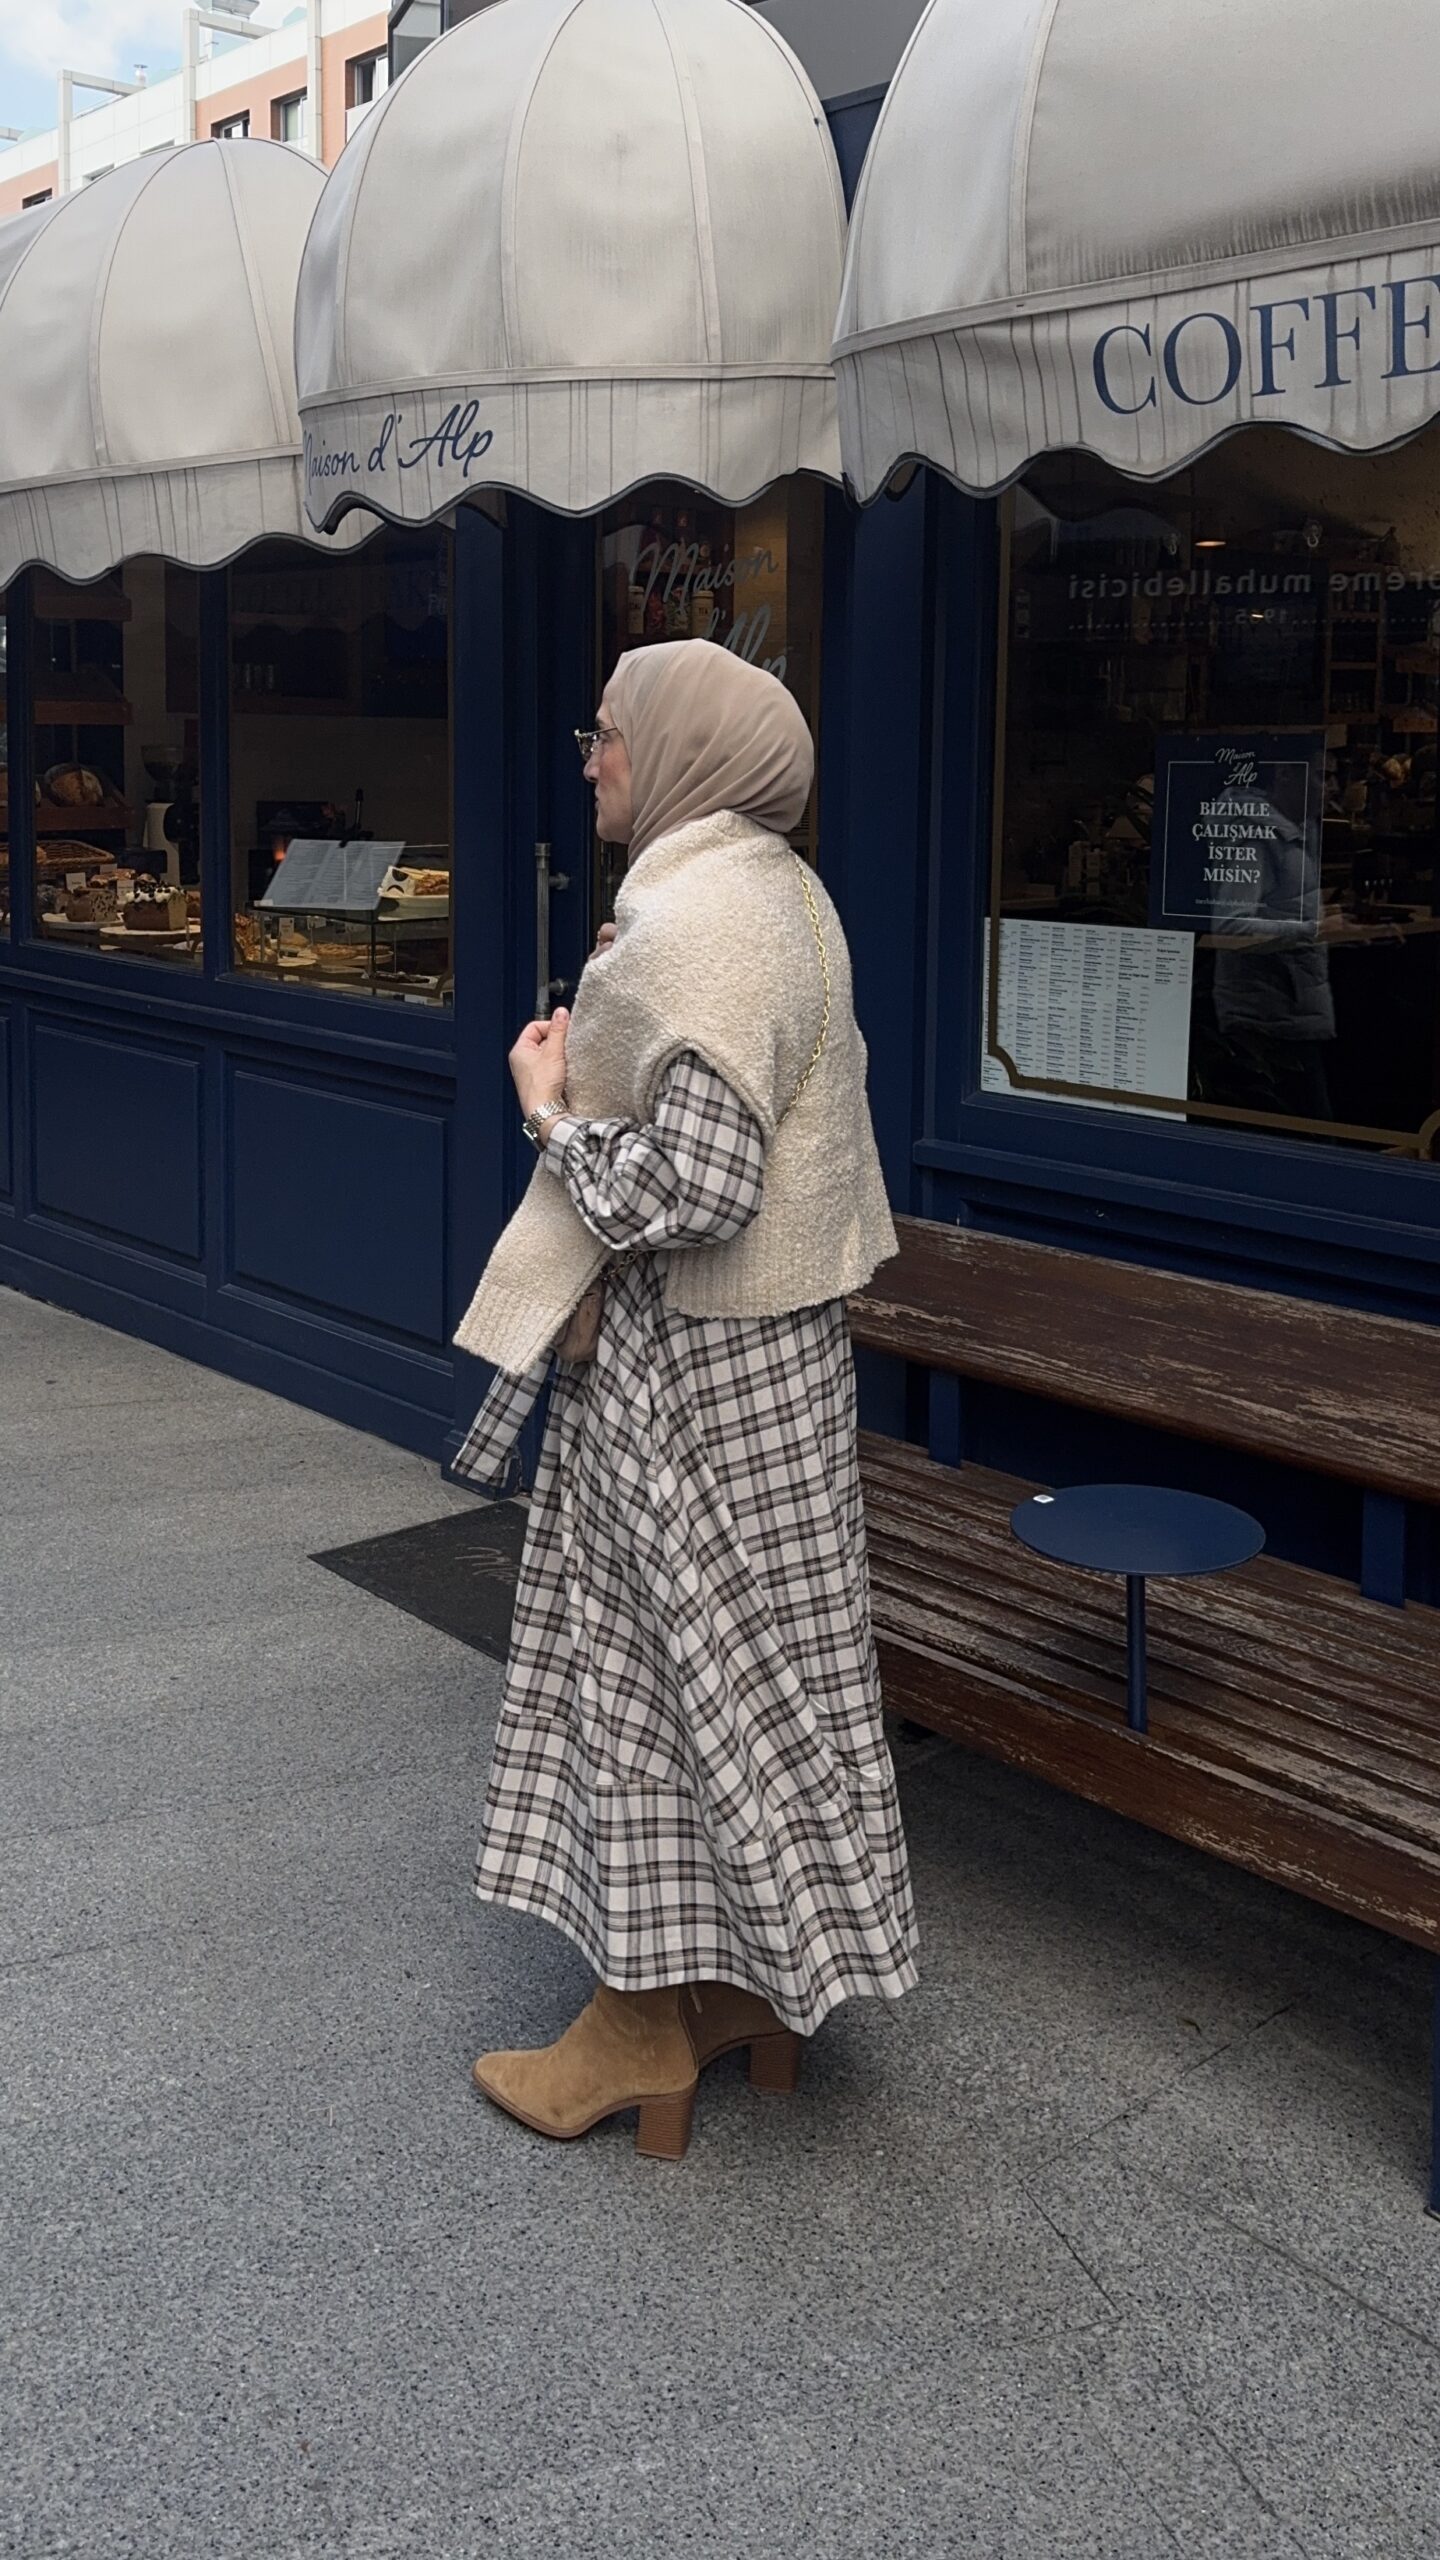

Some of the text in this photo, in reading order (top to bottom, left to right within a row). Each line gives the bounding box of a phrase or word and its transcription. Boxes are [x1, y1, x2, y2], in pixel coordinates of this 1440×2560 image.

[1092, 274, 1440, 415] COFFE
[629, 537, 779, 617] Maison
[1199, 798, 1270, 817] BİZİMLE
[1191, 823, 1278, 842] ÇALIŞMAK
[1208, 842, 1258, 861] İSTER
[1203, 864, 1261, 884] MİSİN?
